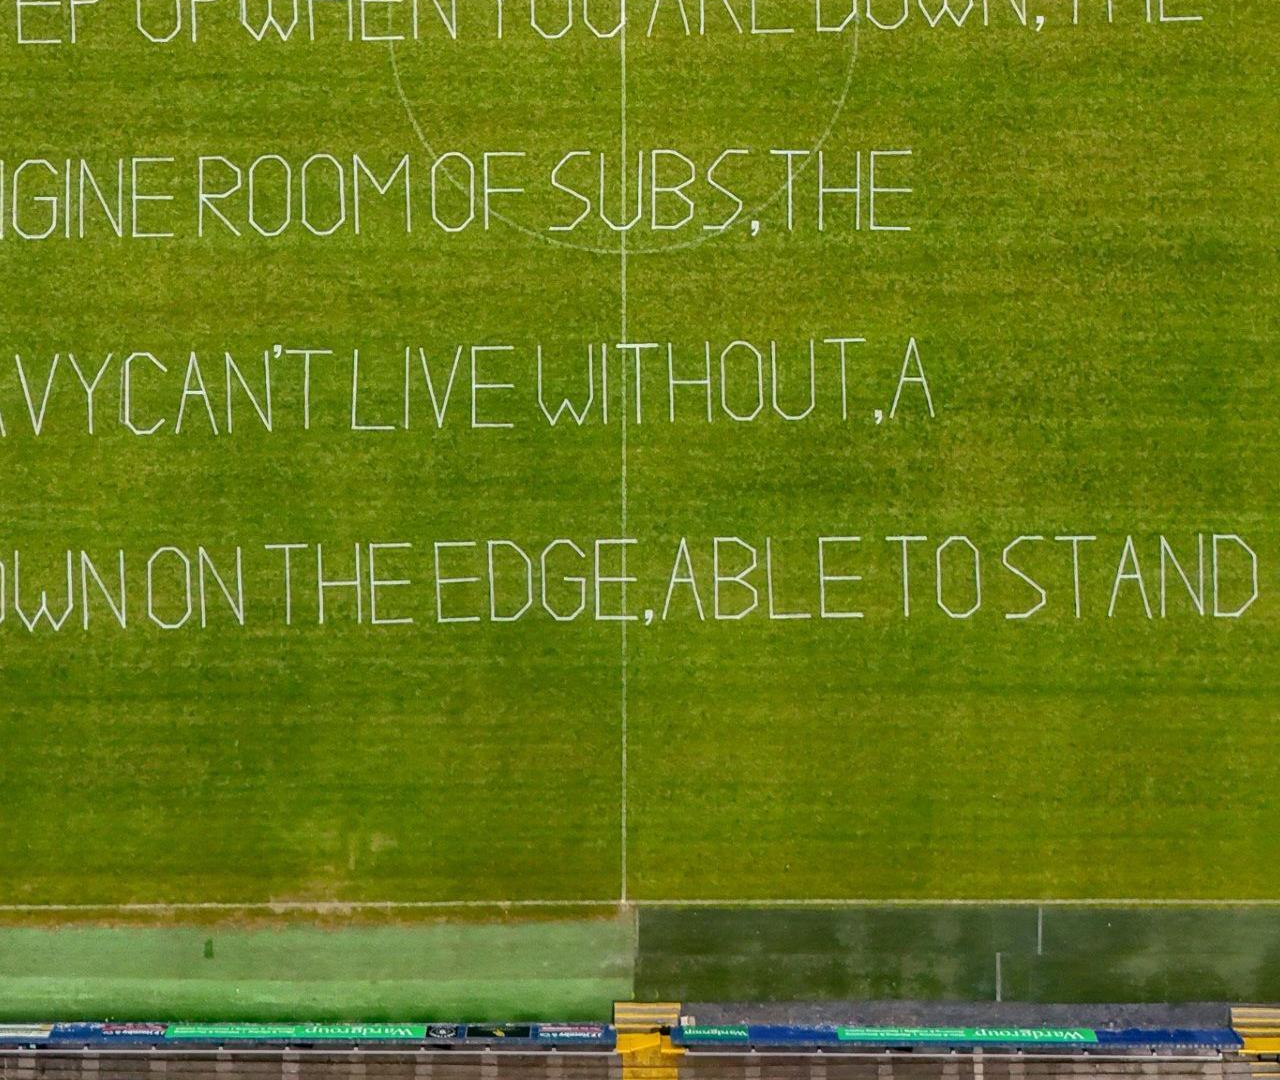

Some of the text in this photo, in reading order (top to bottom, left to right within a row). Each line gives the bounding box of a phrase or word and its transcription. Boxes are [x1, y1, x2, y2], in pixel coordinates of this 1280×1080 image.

[199, 154, 410, 236] ROOM
[432, 152, 523, 232] OF
[771, 150, 911, 230] THE
[121, 345, 330, 435] CAN'T
[352, 346, 513, 429] LIVE
[891, 338, 934, 418] A
[148, 547, 243, 628] ON
[265, 543, 412, 624] THE
[663, 537, 863, 620] ABLE
[886, 536, 980, 618] TO
[1003, 534, 1257, 618] STAND
[304, 1026, 414, 1037] Wardgroup
[683, 1027, 748, 1037] Wardgroup
[974, 1029, 1084, 1040] Wardgroup
